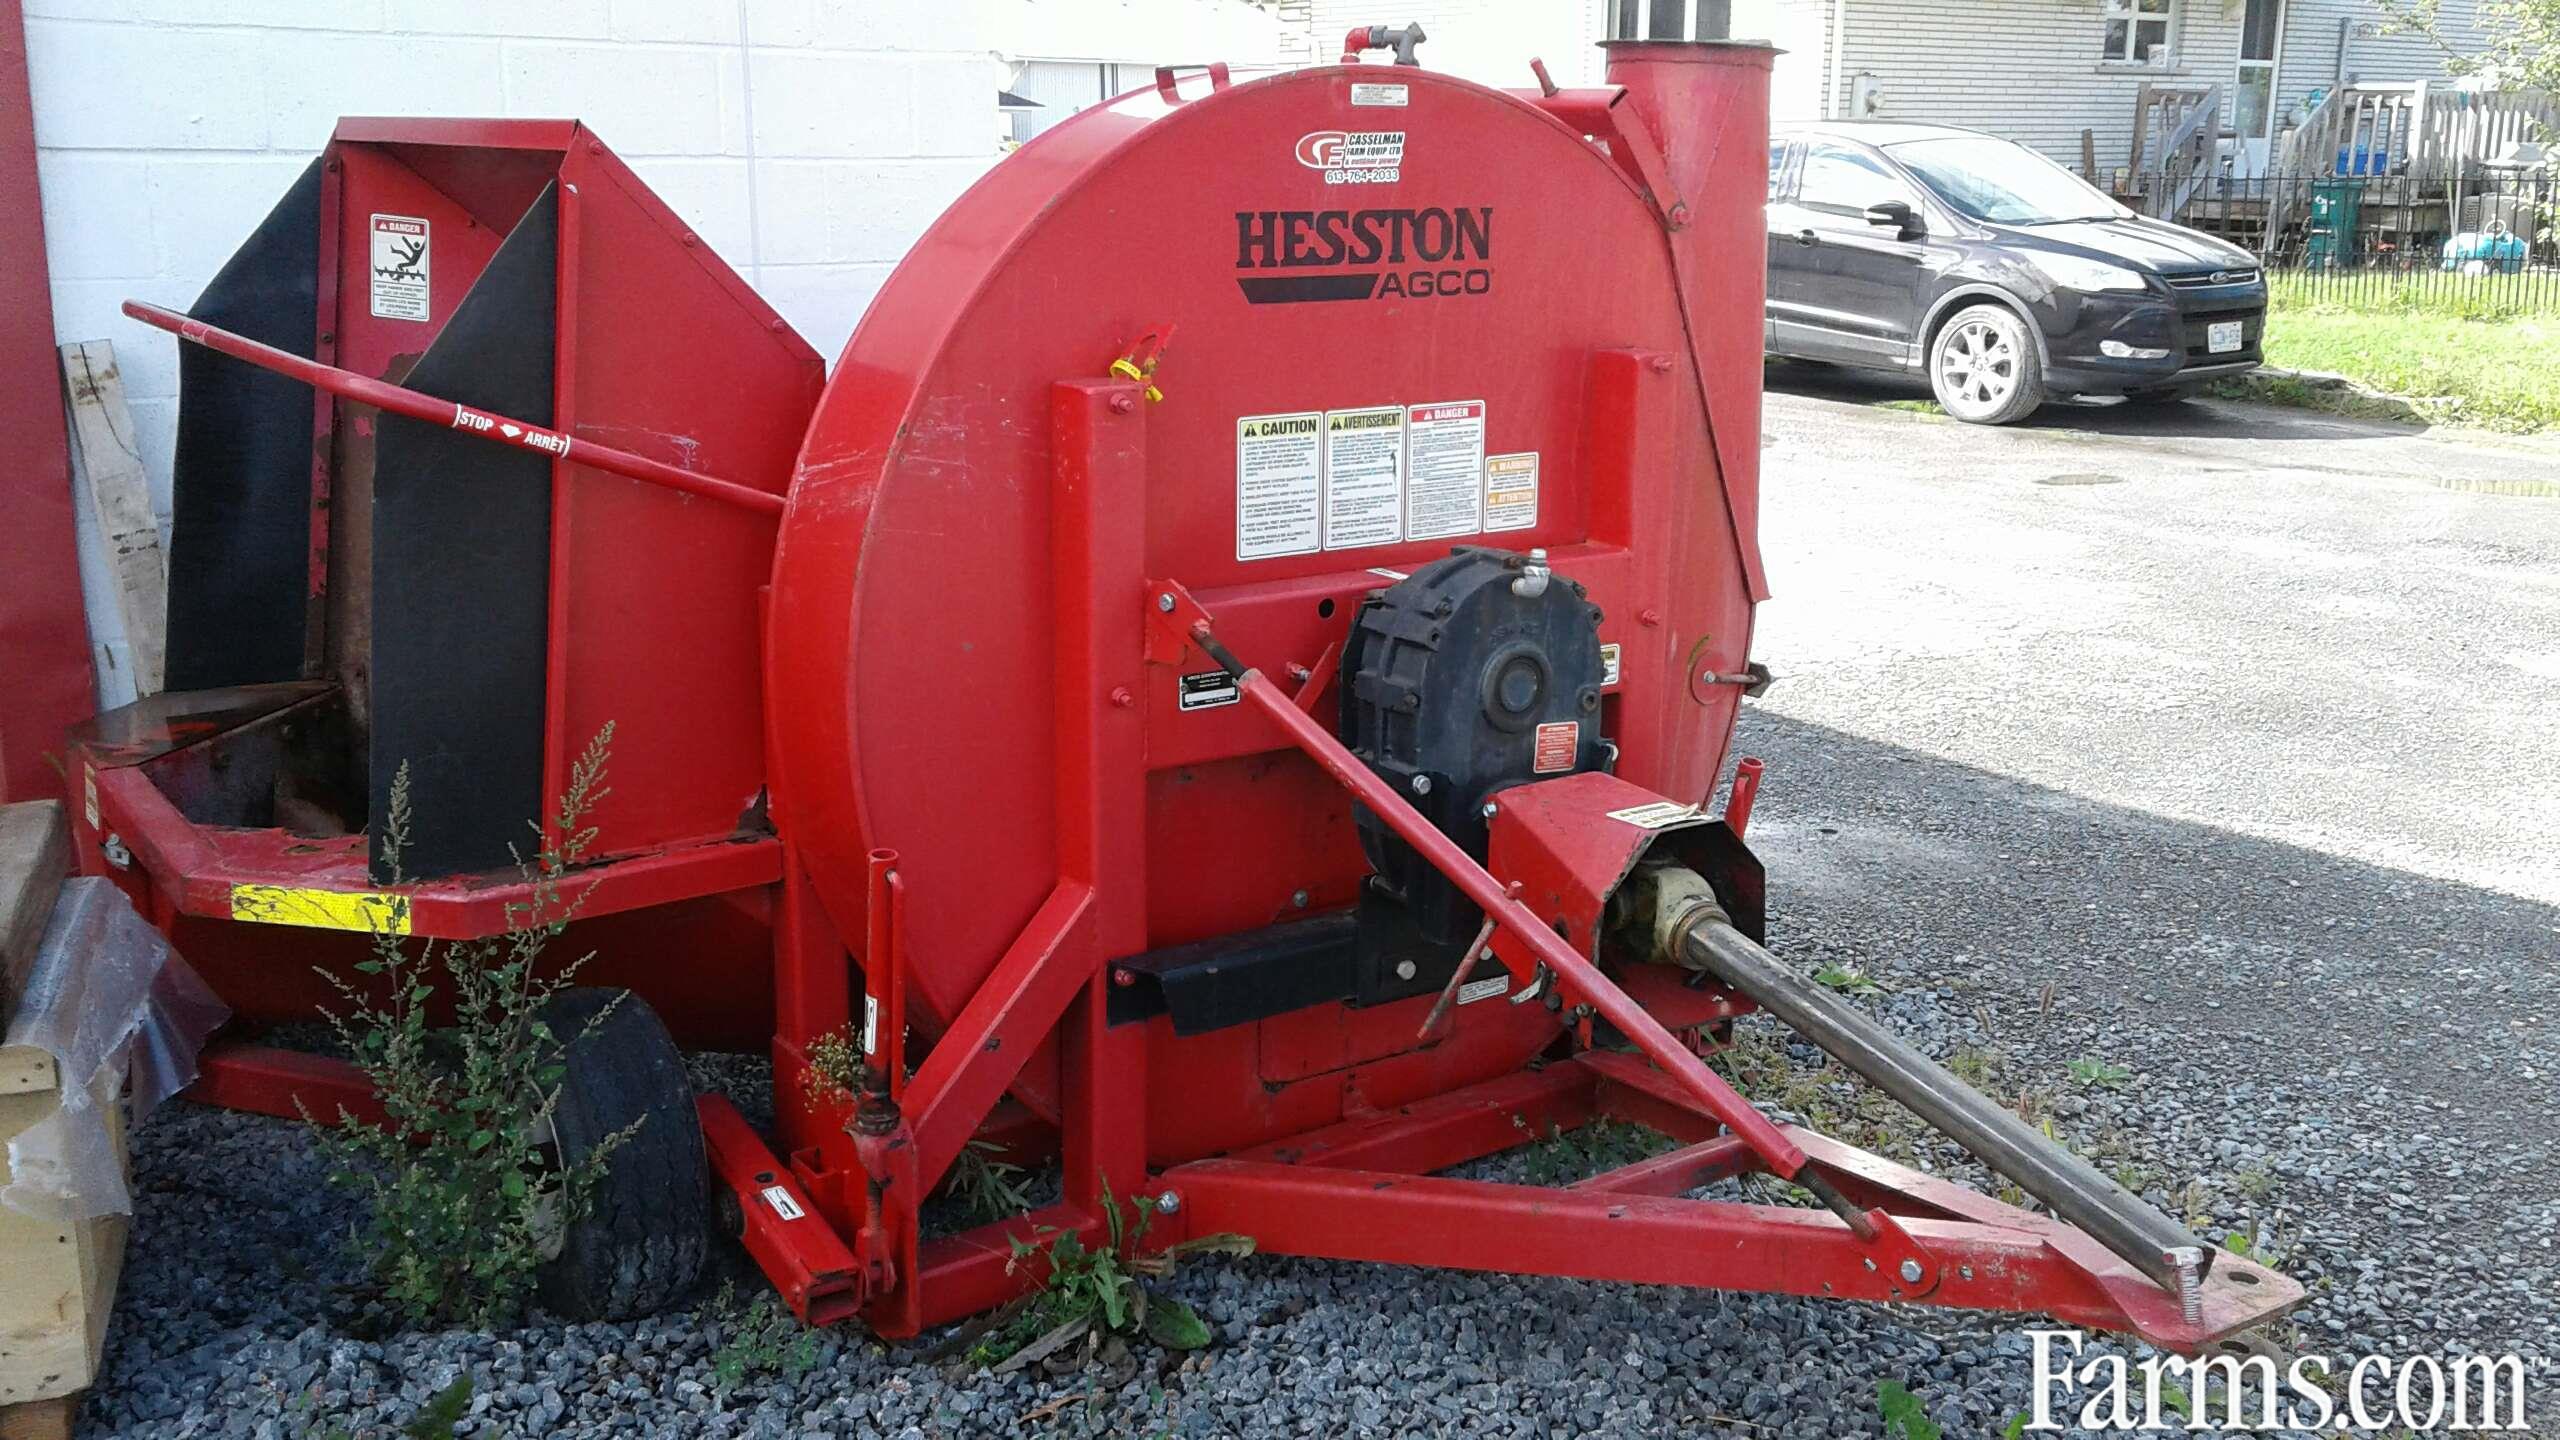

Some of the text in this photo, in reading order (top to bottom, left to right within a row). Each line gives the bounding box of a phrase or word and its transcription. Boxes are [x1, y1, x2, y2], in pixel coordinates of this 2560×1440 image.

[1349, 134, 1403, 145] CASSELMAN
[1347, 147, 1366, 156] FARM
[1367, 146, 1387, 156] EQUIP
[1326, 171, 1398, 182] 613-764-2033
[389, 222, 420, 233] DANGER
[1235, 207, 1494, 268] HESSTON
[1376, 268, 1491, 300] AGCO
[1343, 412, 1401, 429] AVERTISSEMENT
[1434, 407, 1469, 420] DANGER
[460, 411, 567, 453] STOP ARRÊT
[1261, 418, 1317, 436] CAUTION
